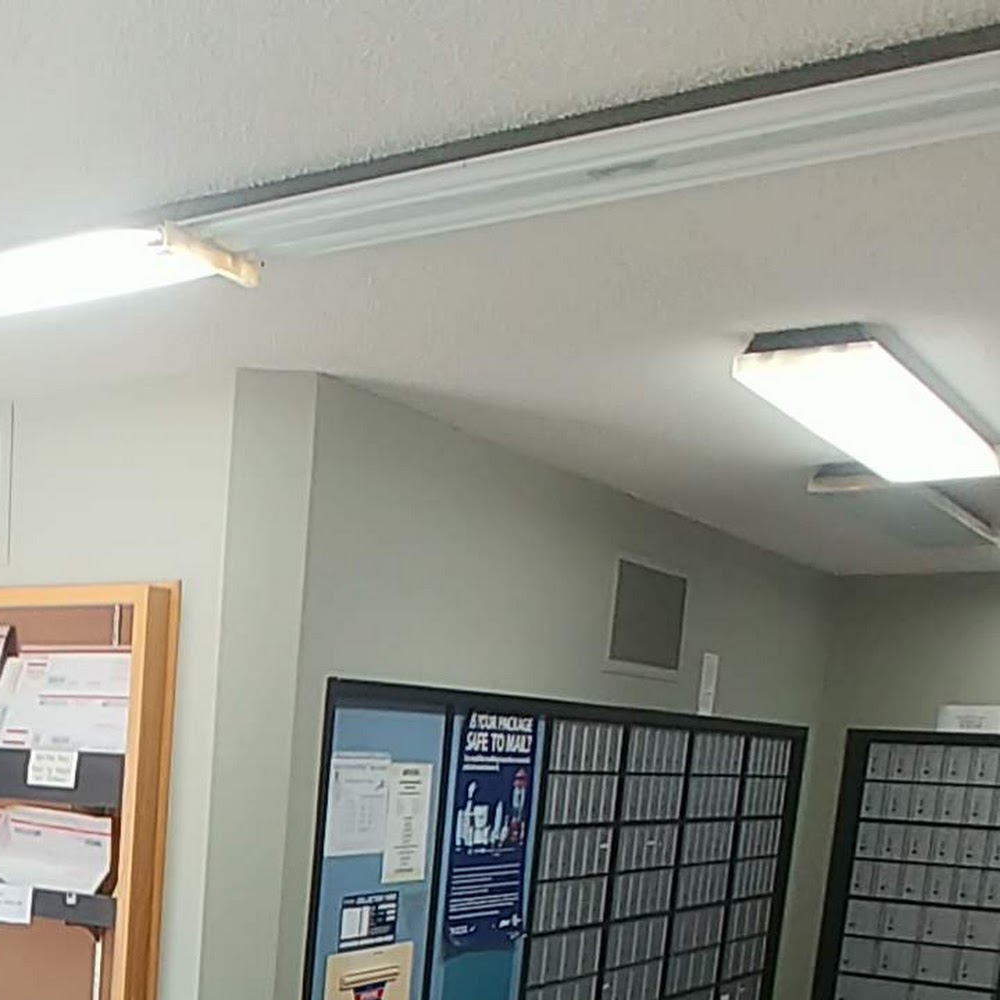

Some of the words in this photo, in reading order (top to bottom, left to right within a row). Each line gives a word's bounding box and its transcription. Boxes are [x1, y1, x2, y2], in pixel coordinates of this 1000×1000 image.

[478, 714, 498, 730] YOUR
[498, 715, 534, 733] PACKAGE
[465, 731, 489, 752] SAFE
[490, 732, 505, 752] TO
